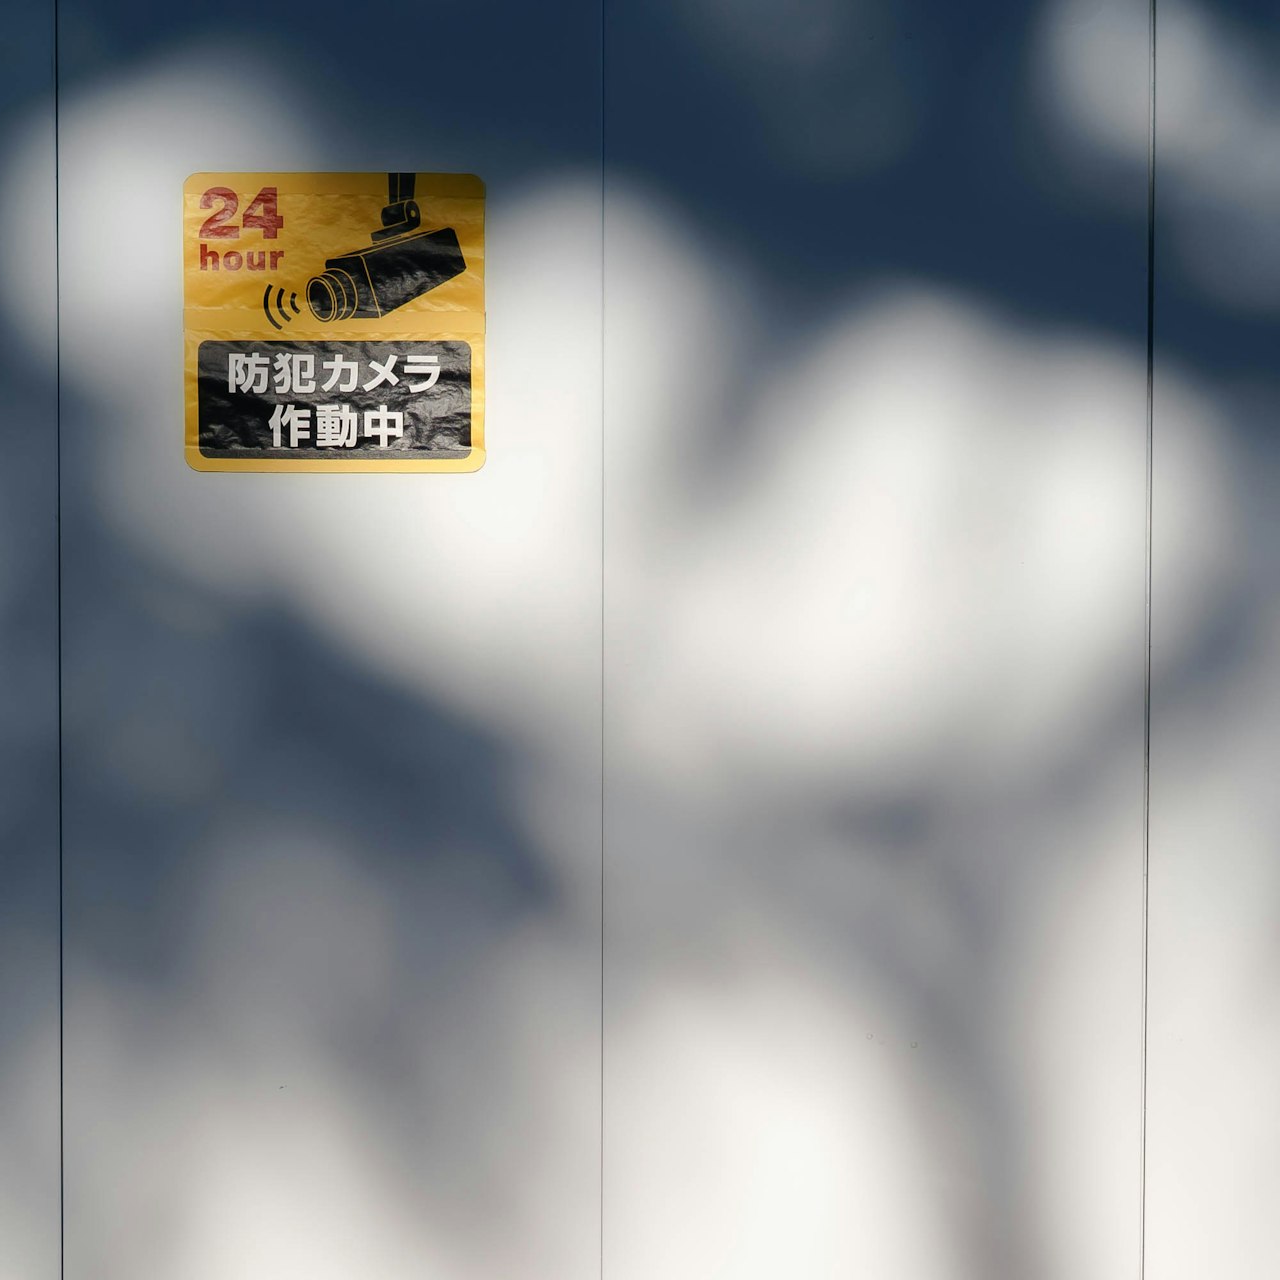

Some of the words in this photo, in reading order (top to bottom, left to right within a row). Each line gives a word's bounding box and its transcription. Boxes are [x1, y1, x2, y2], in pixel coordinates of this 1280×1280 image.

[198, 187, 284, 240] 24
[200, 244, 285, 271] hour
[227, 353, 441, 394] 防犯カメラ
[268, 405, 404, 448] 作動中
